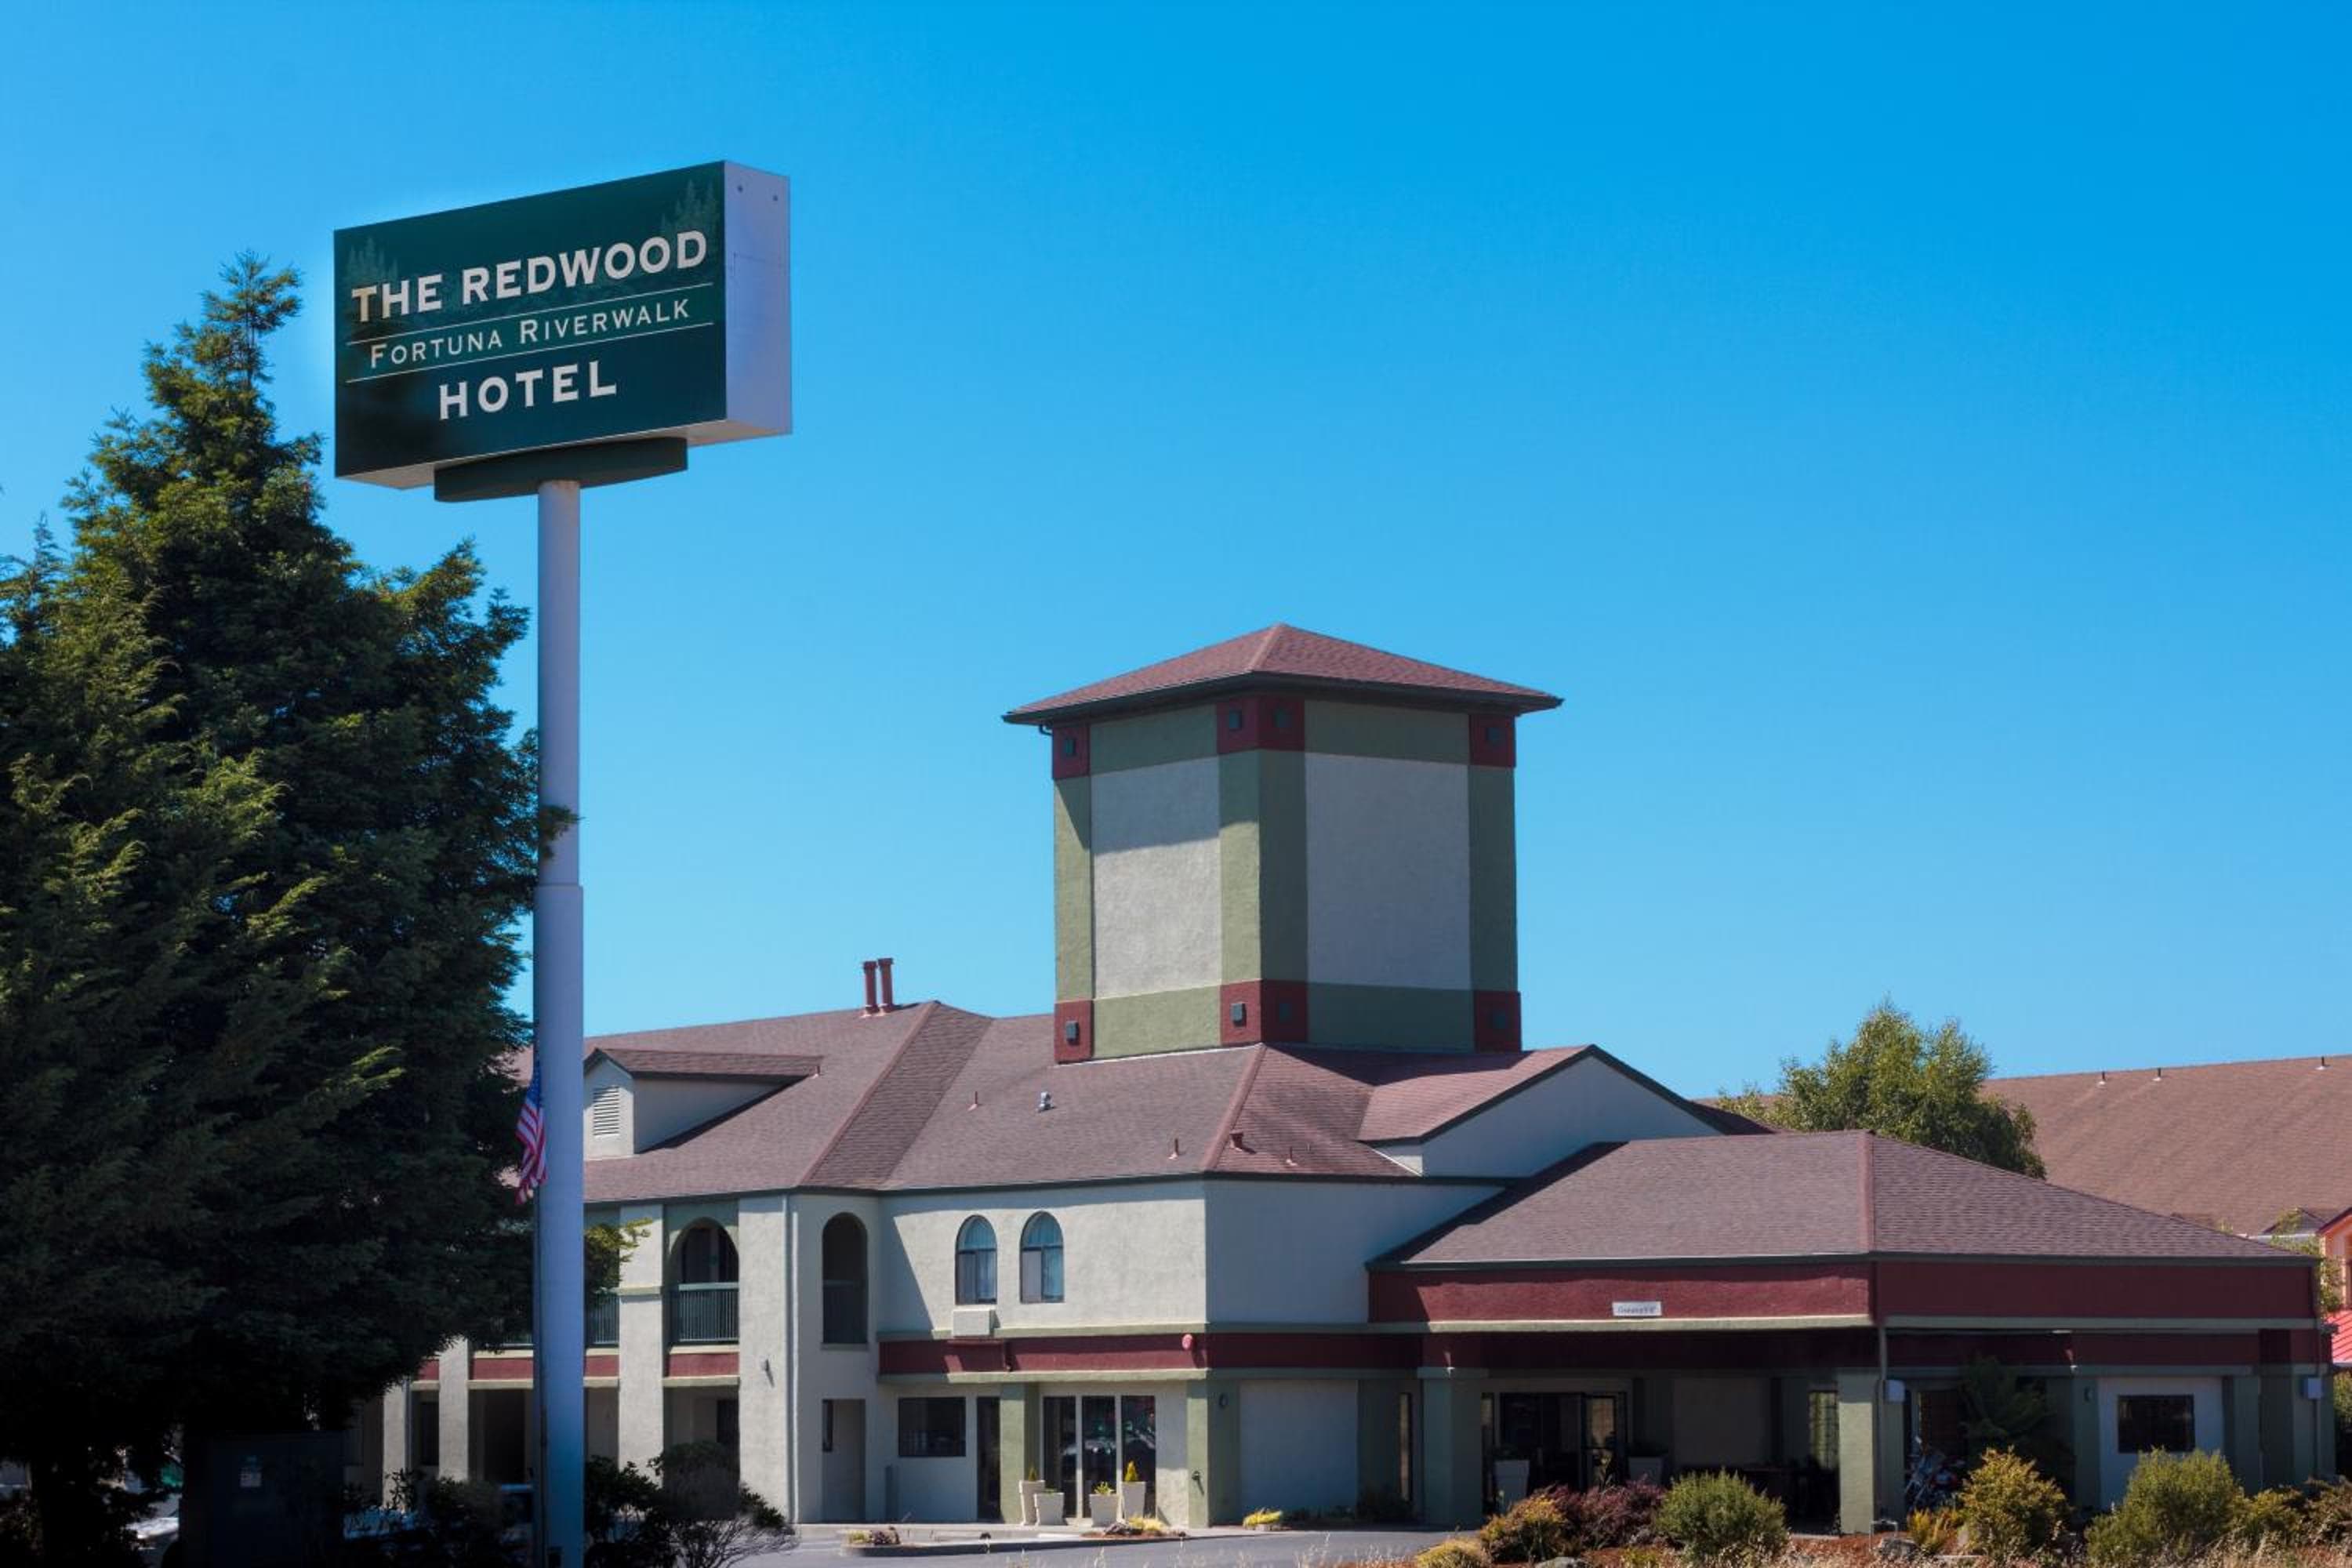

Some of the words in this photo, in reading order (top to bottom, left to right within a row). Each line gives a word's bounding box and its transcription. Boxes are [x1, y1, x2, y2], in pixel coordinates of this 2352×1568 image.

[351, 274, 443, 322] THE
[463, 230, 707, 305] REDWOOD
[370, 329, 503, 368] FORTUNA
[519, 299, 690, 344] RIVERWALK
[438, 361, 618, 420] HOTEL
